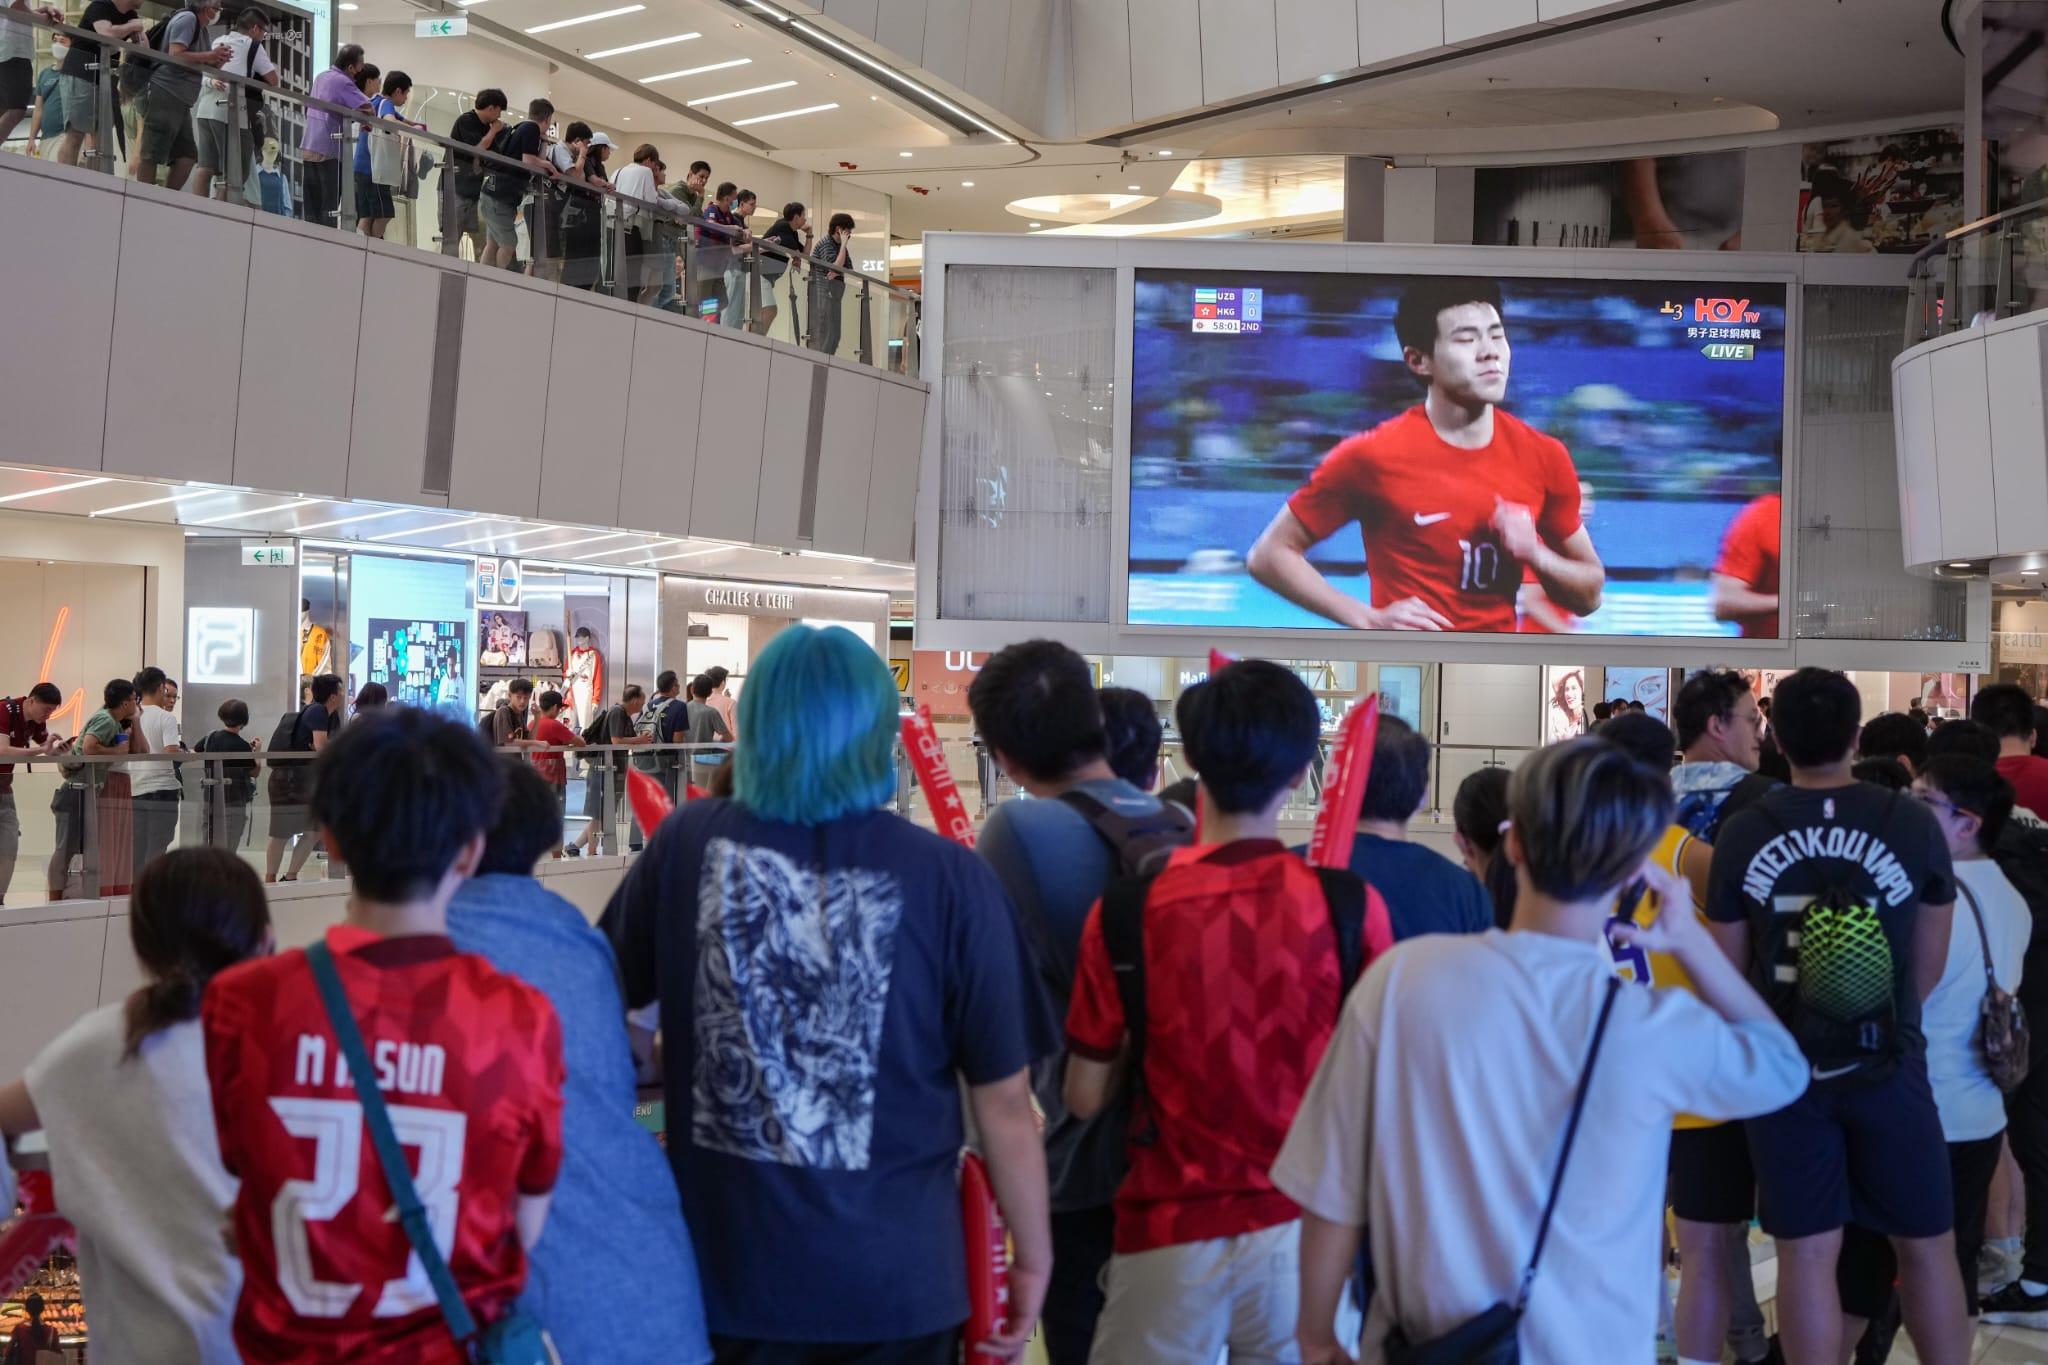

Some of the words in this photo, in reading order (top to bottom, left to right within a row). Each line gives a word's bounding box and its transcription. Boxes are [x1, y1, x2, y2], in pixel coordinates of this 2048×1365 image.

[1217, 292, 1235, 301] UZB
[1249, 292, 1256, 302] 2
[1248, 308, 1256, 317] 0
[1694, 298, 1749, 322] HOY
[1744, 312, 1760, 323] TV
[1213, 322, 1238, 331] 58:01
[1241, 322, 1259, 331] 2ND
[1710, 345, 1745, 358] LIVE
[1458, 539, 1498, 590] 10
[754, 593, 762, 608] &
[766, 593, 795, 610] KEITH
[374, 1039, 447, 1097] SUN
[632, 1103, 652, 1119] ENU
[266, 1096, 468, 1319] 23
